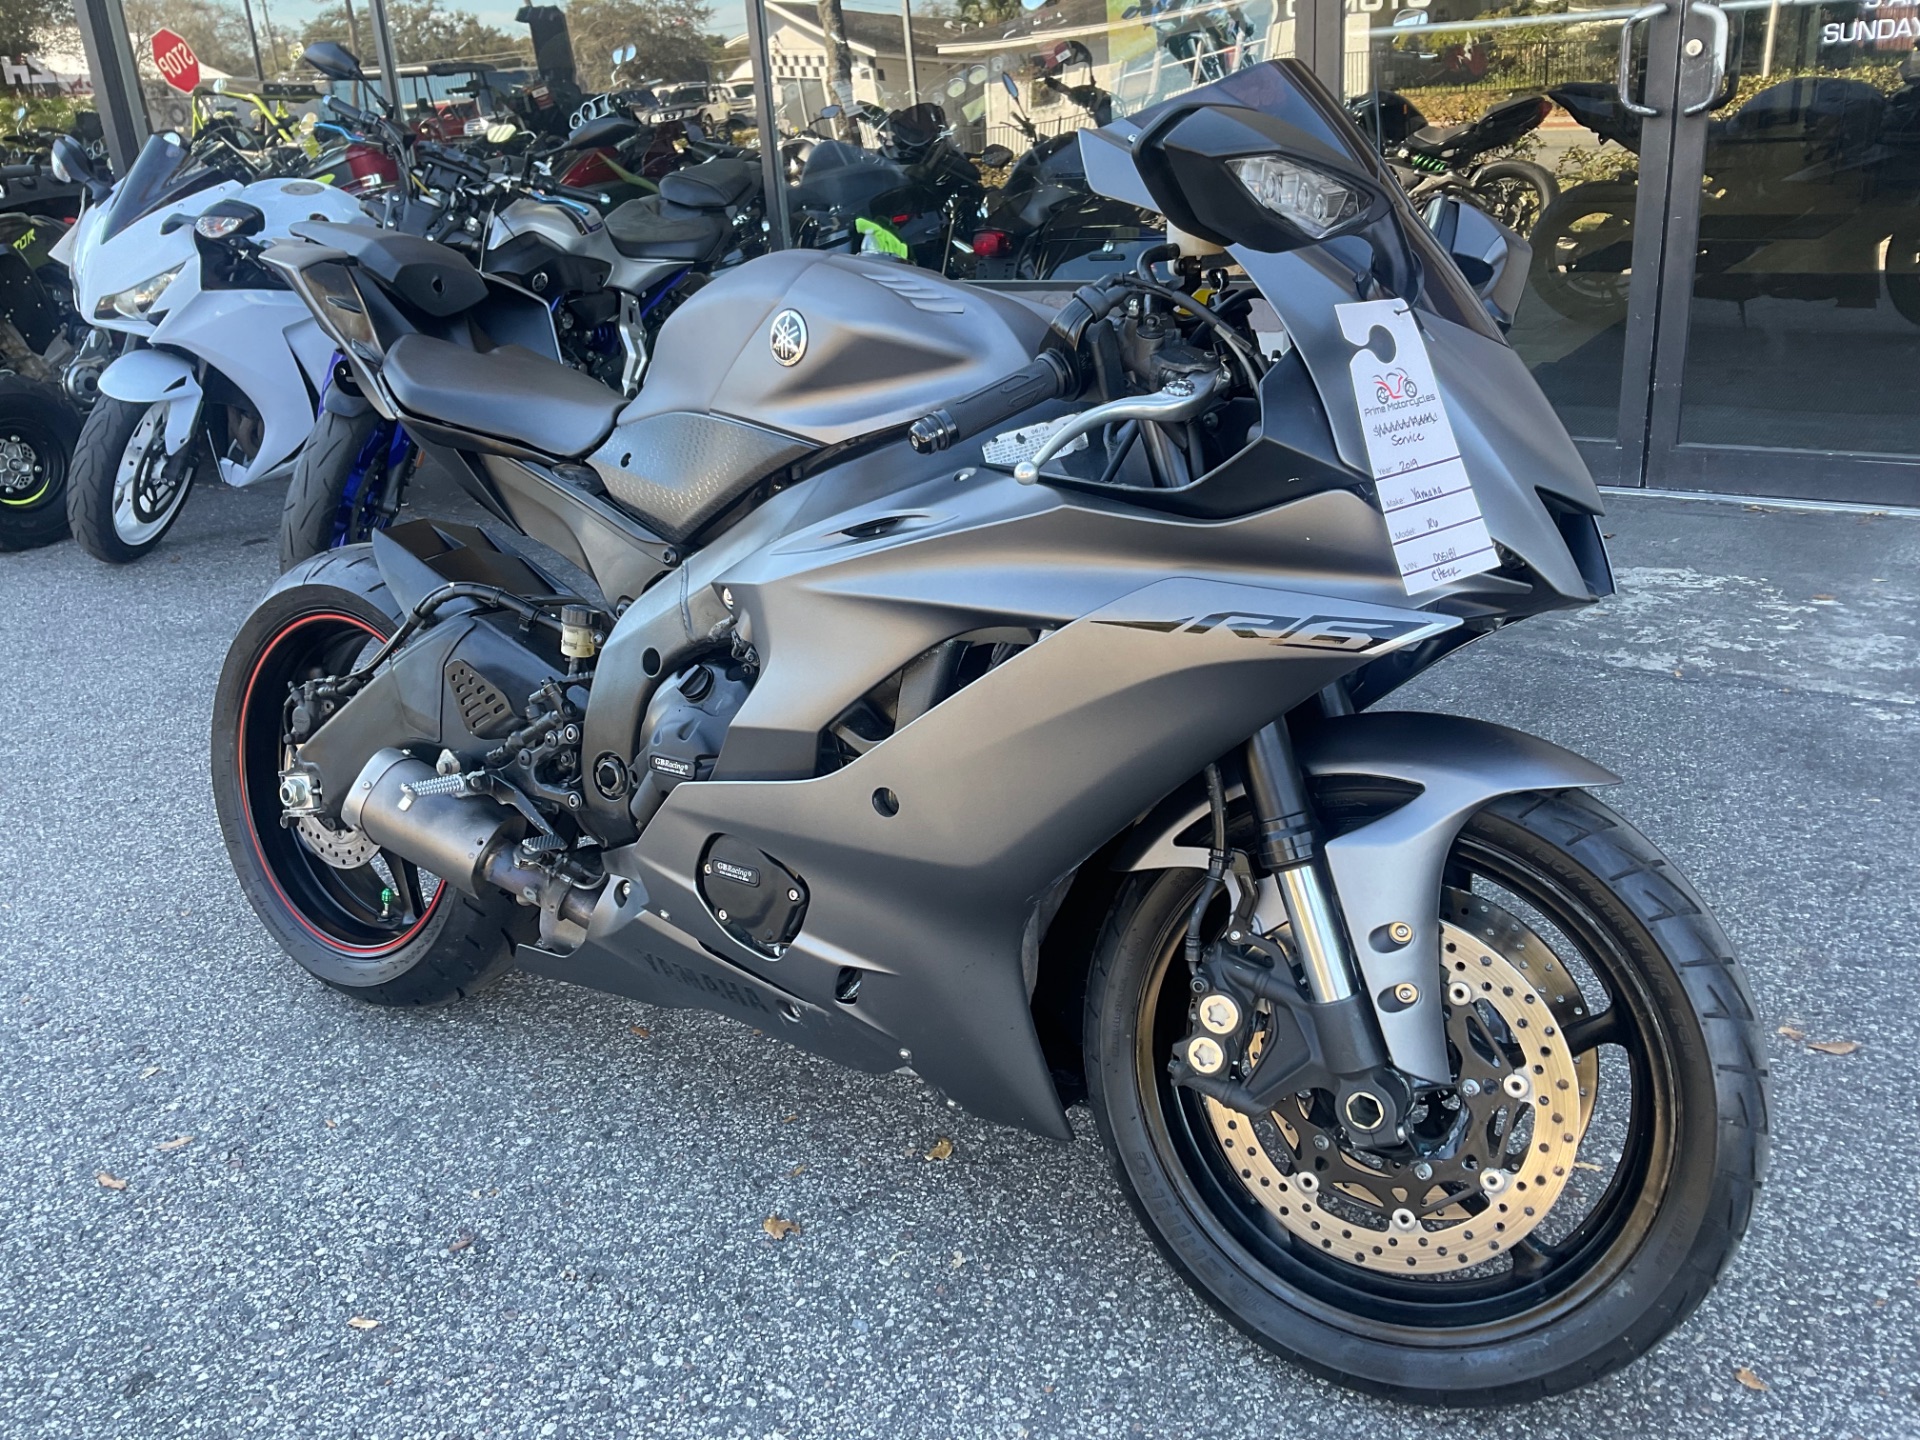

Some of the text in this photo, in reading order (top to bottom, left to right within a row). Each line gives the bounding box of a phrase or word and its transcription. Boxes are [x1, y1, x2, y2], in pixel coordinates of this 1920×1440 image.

[1364, 393, 1436, 417] Prime Motorcycles
[1391, 432, 1424, 446] Service
[1399, 458, 1419, 471] 2019
[640, 949, 770, 1013] YAMAHA
